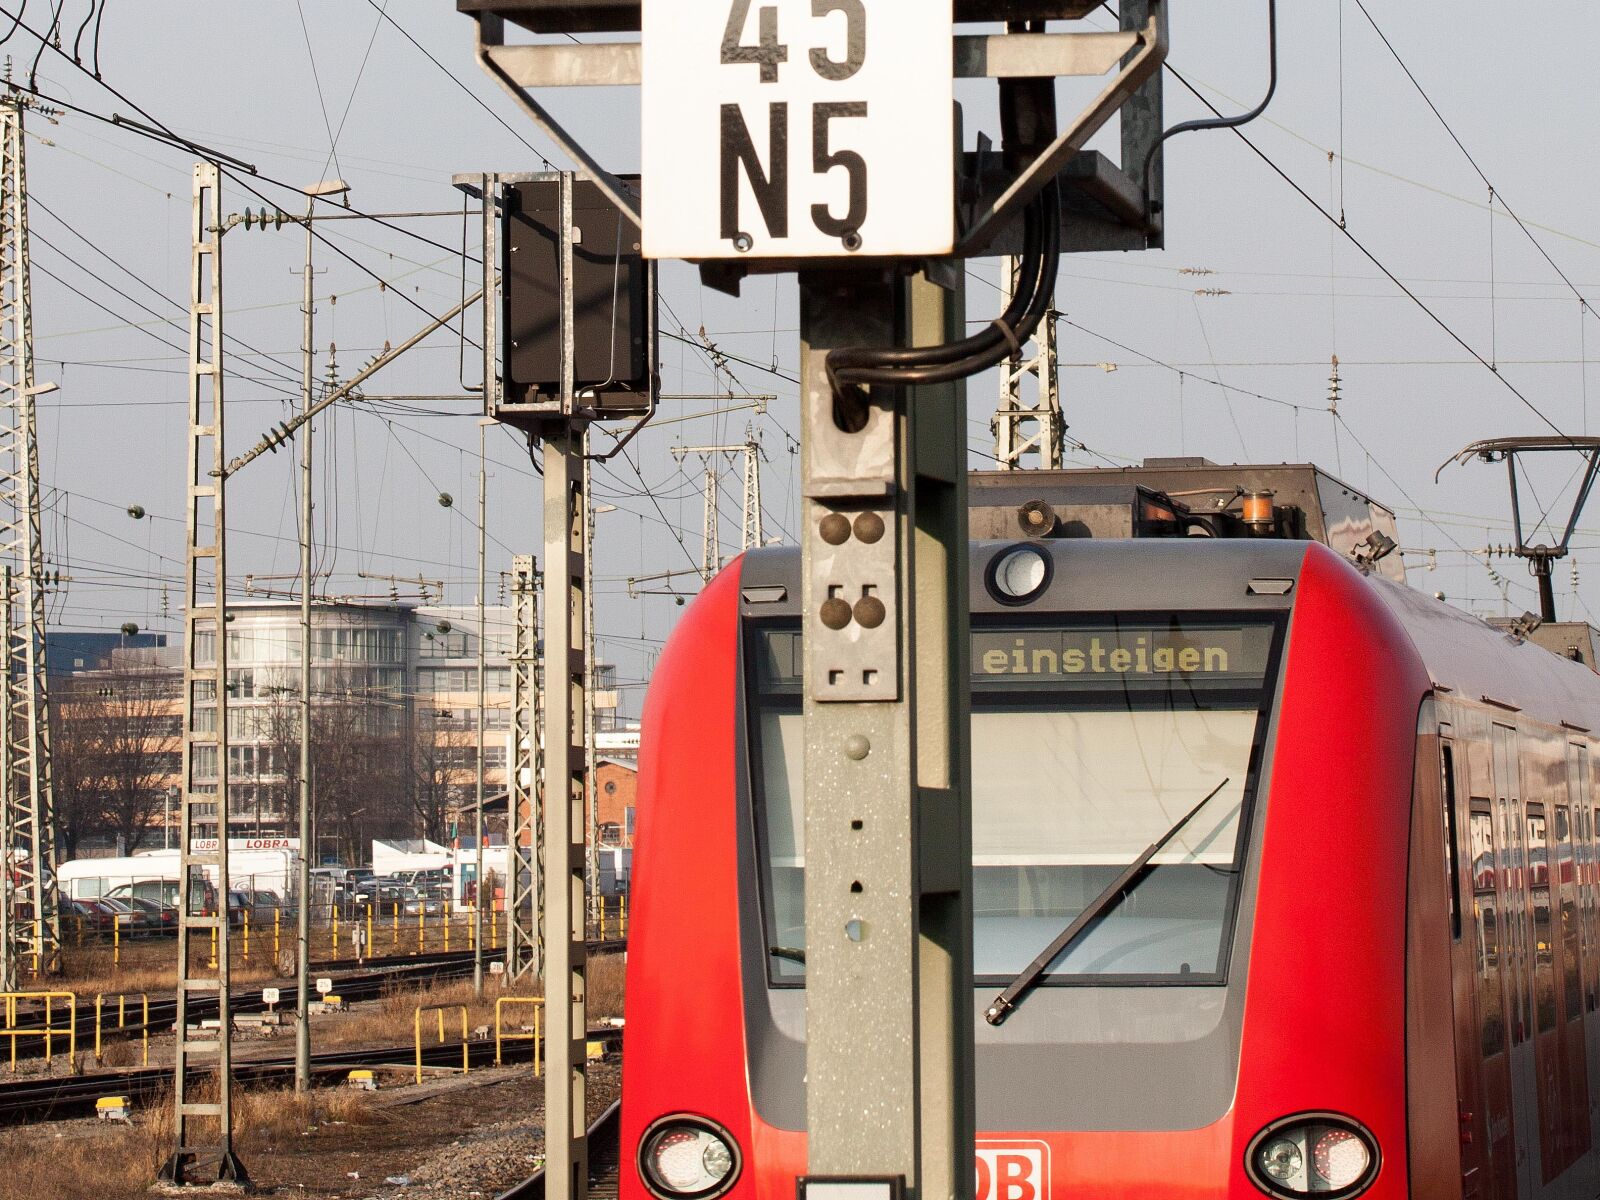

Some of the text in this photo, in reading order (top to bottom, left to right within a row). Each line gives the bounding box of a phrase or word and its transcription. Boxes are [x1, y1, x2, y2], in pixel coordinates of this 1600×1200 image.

[720, 101, 868, 240] N5
[982, 637, 1229, 674] einsteigen
[195, 840, 218, 849] LOBR
[246, 840, 289, 849] LOBRA
